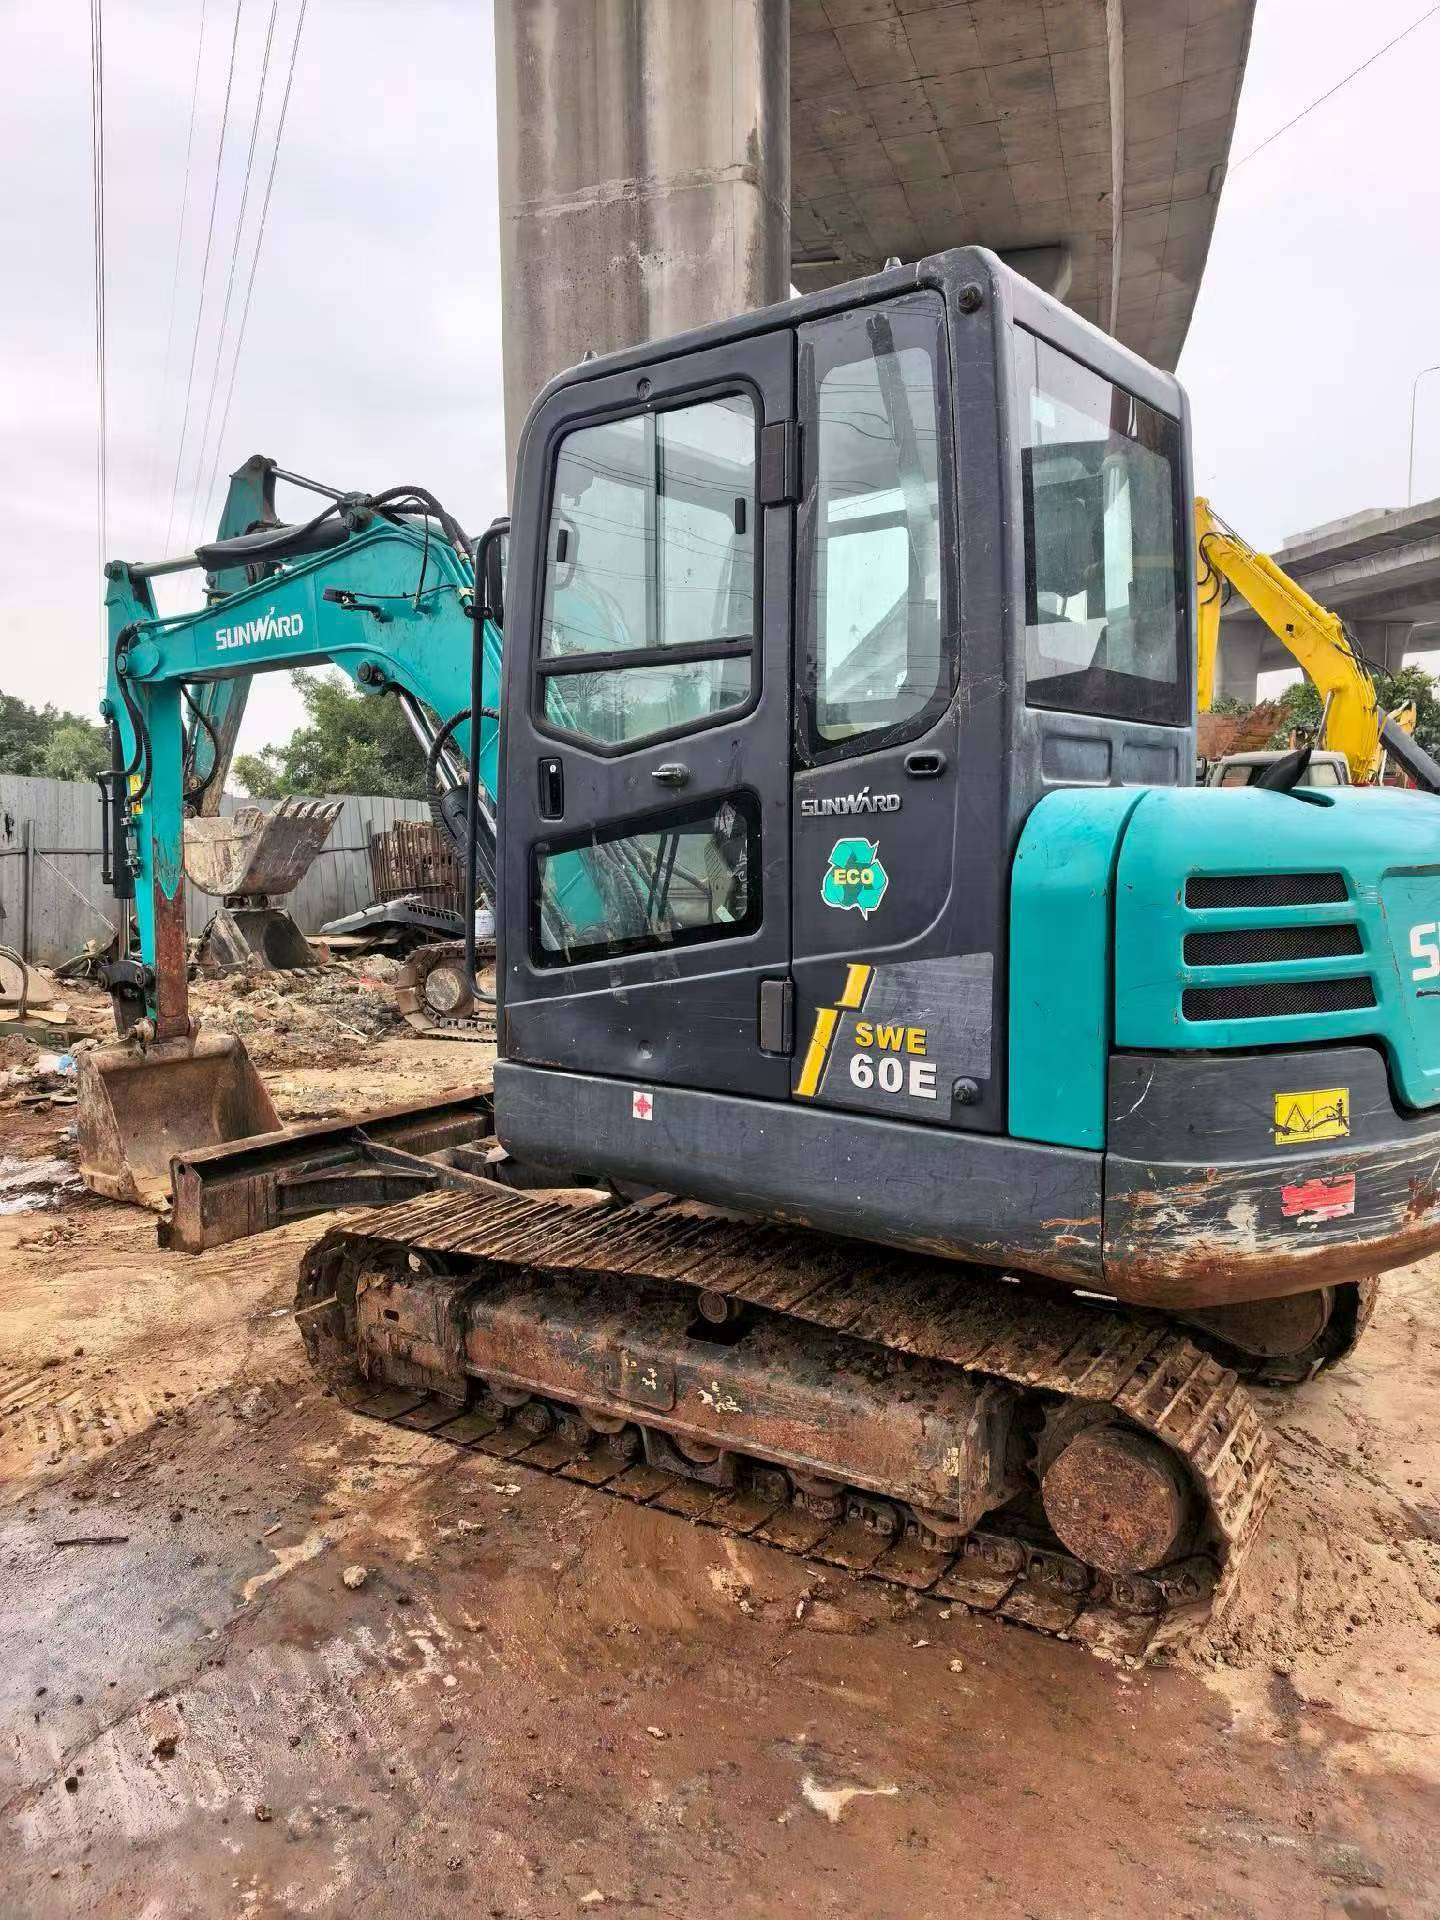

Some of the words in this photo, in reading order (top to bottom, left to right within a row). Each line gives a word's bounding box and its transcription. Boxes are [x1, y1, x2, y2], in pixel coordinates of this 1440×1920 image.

[215, 606, 304, 651] SUNWARD
[801, 786, 901, 817] SUNWARD
[834, 868, 874, 885] ECO
[1410, 922, 1440, 981] S
[855, 1022, 928, 1055] SWE
[849, 1053, 937, 1100] 60E
